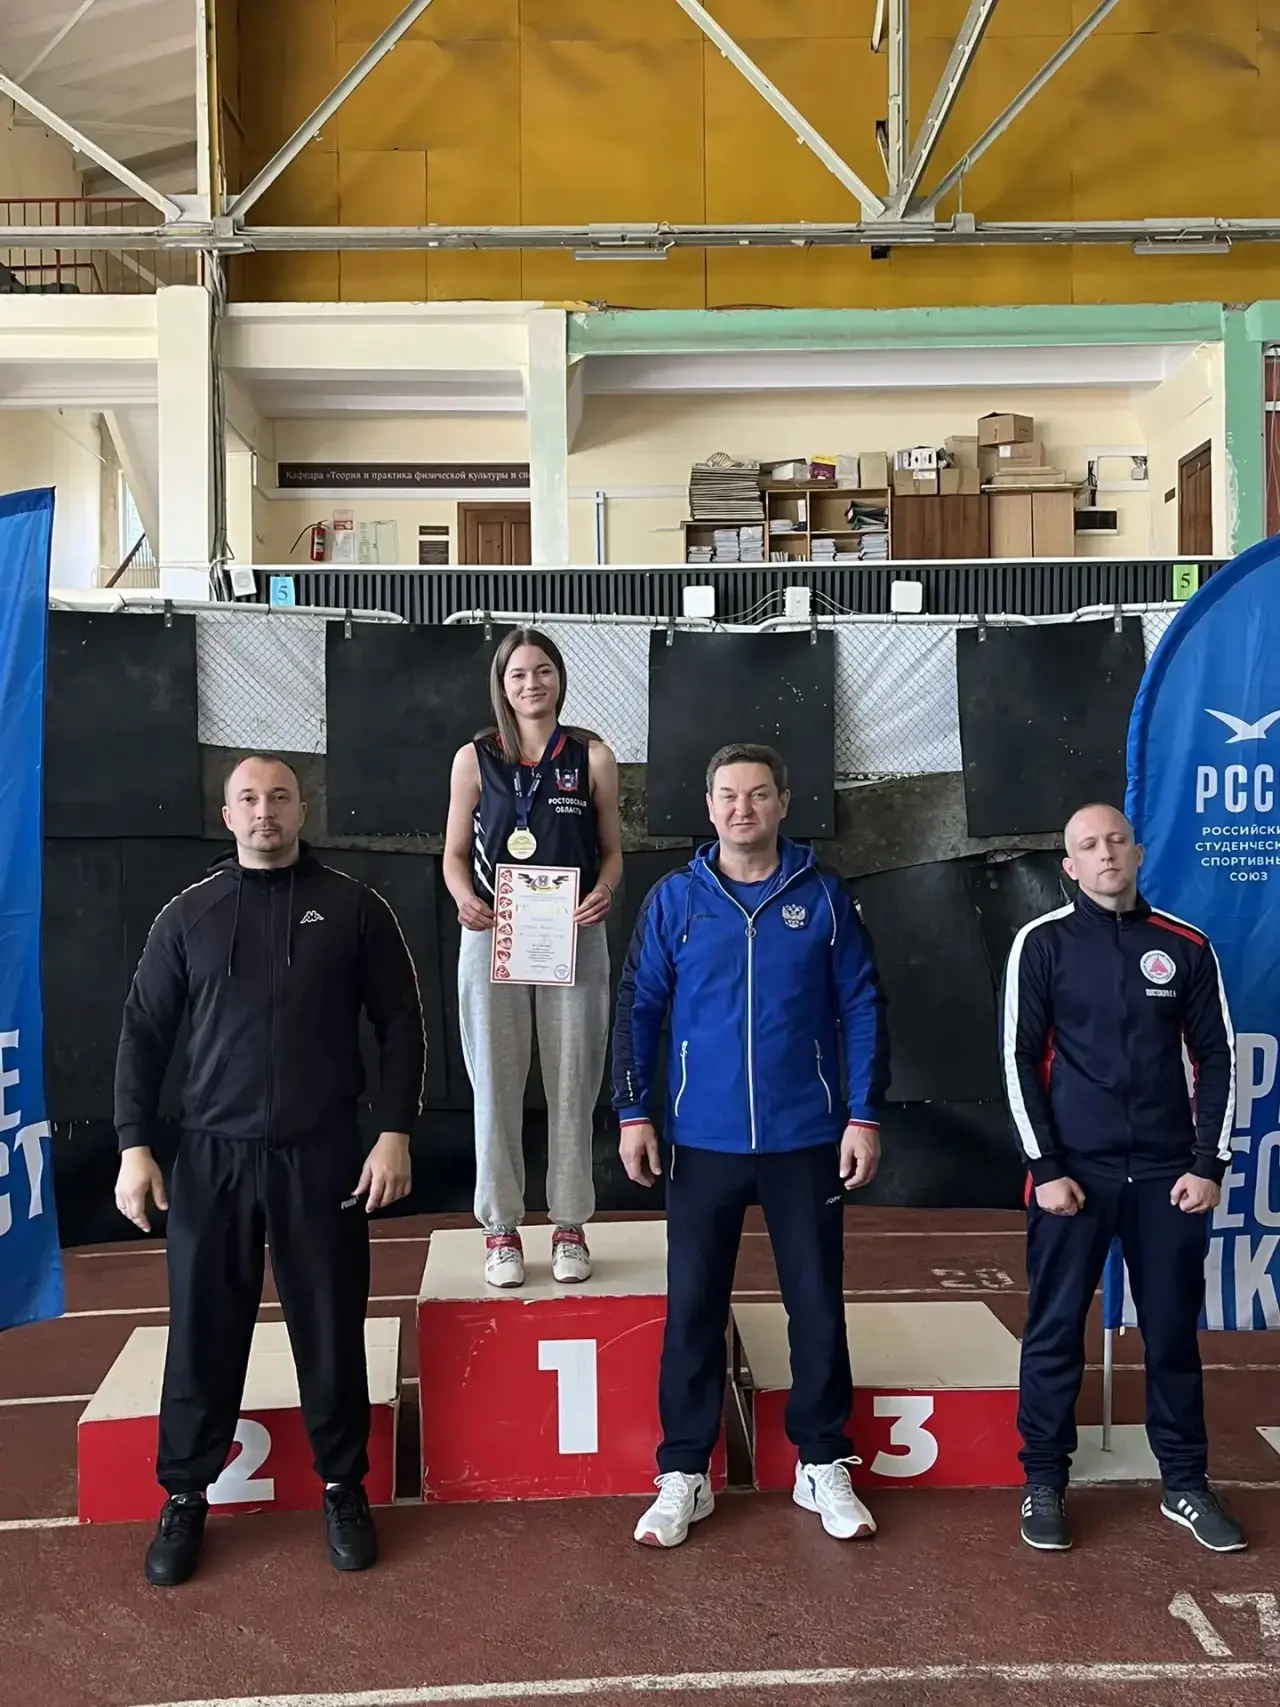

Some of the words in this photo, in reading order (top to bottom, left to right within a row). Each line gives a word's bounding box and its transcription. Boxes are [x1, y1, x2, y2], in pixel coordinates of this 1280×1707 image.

[286, 471, 323, 481] Кафедра
[371, 472, 413, 481] практика
[414, 470, 466, 481] физической
[468, 472, 509, 481] культуры
[511, 472, 517, 480] и
[518, 472, 531, 480] сп
[1181, 573, 1190, 588] 5
[278, 585, 288, 600] 5
[1230, 872, 1268, 881] СОЮЗ
[538, 1339, 599, 1455] 1
[870, 1396, 938, 1478] 3
[206, 1419, 275, 1505] 2
